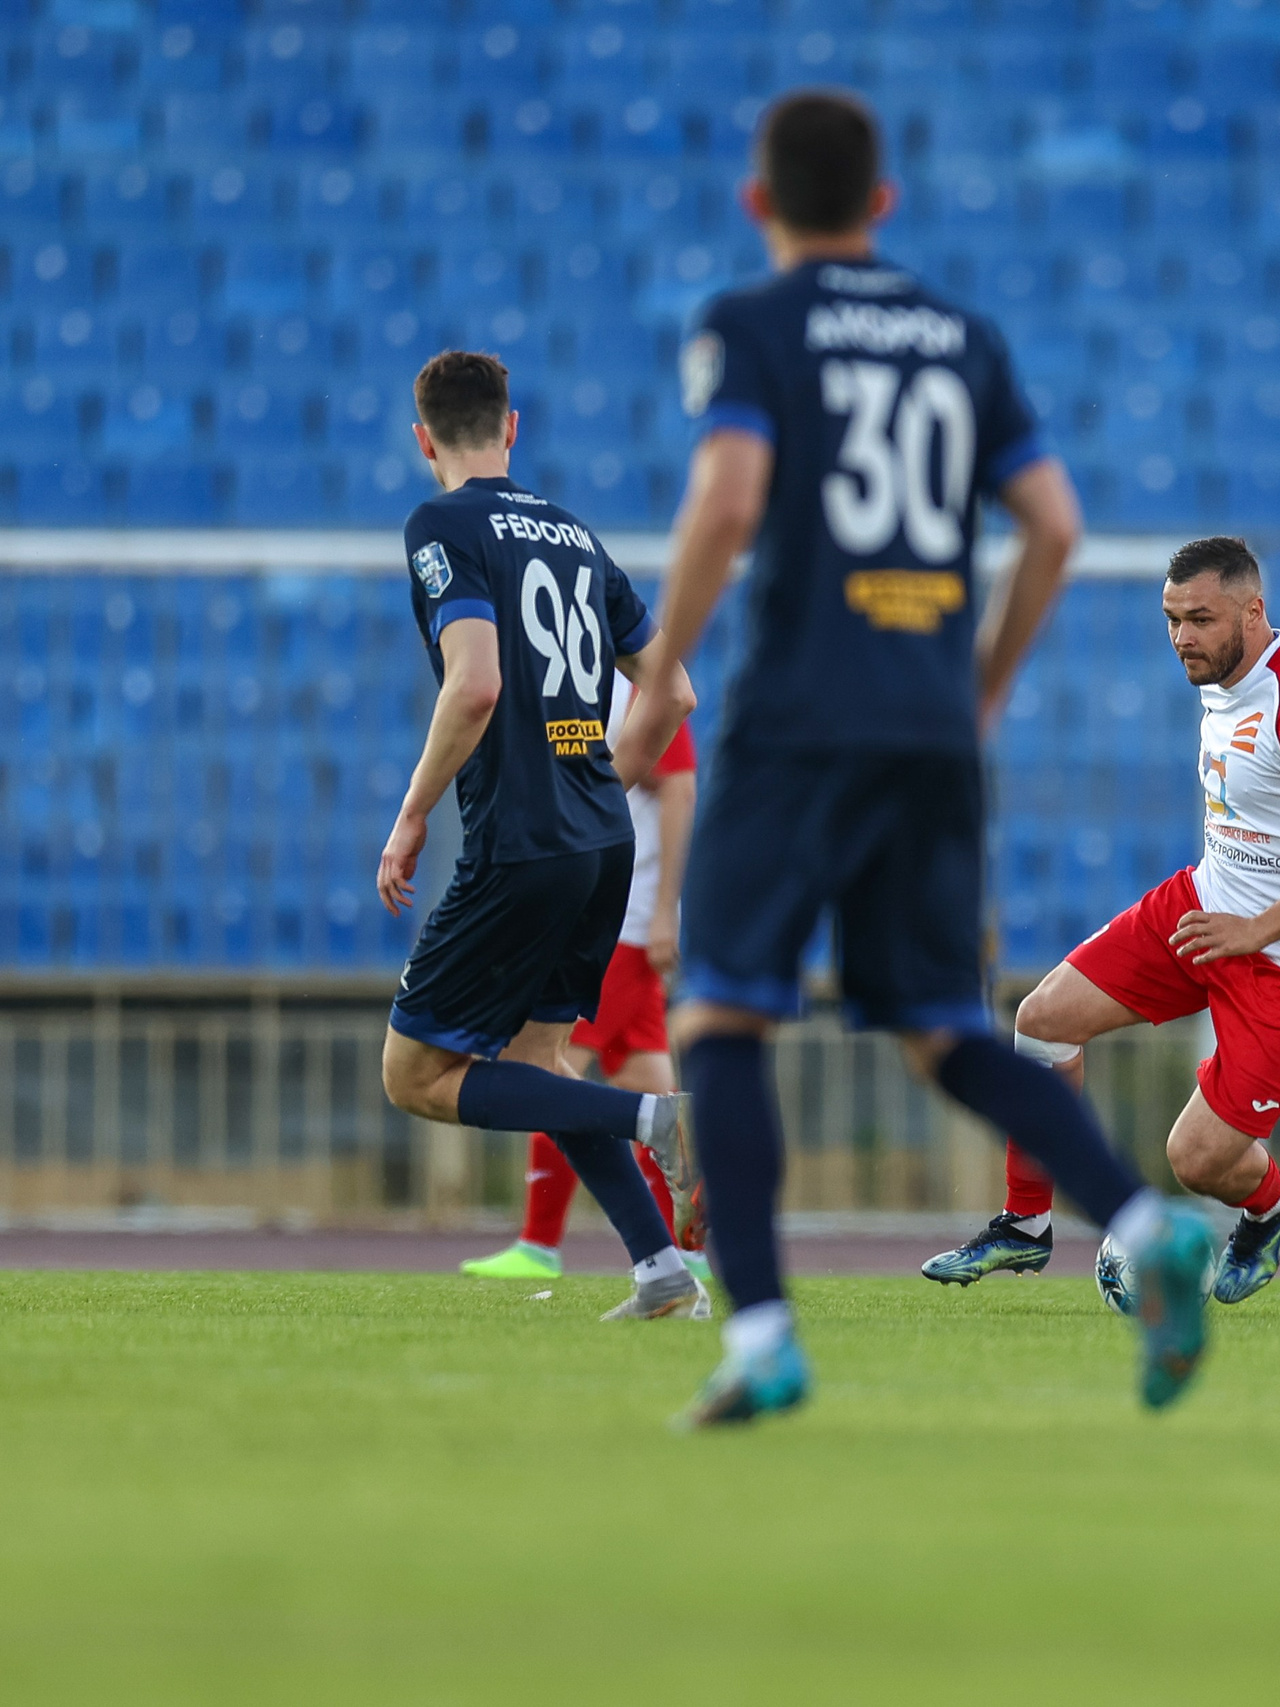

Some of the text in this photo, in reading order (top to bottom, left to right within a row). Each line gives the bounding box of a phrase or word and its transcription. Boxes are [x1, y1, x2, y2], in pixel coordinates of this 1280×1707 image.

[488, 513, 596, 555] FEDORIN
[821, 359, 977, 565] 30
[521, 557, 602, 704] 96
